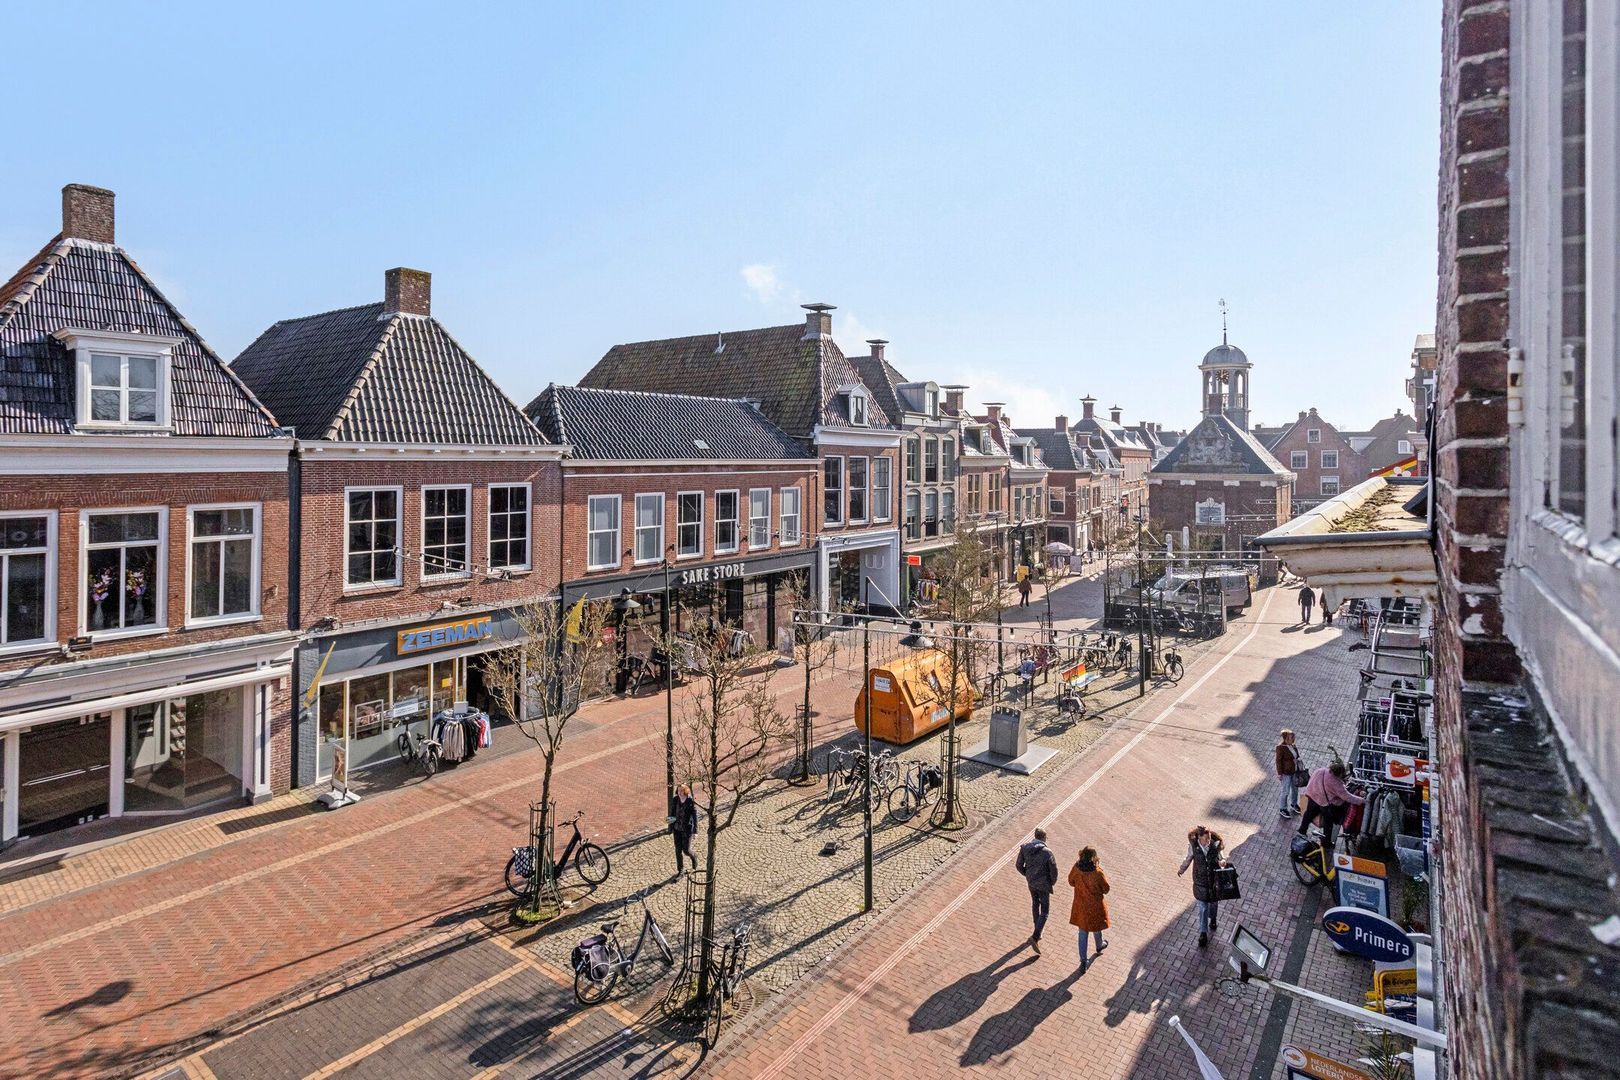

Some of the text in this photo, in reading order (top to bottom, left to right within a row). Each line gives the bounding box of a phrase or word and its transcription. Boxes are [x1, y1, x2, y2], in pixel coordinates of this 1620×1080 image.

[682, 563, 745, 585] SAKE STORE
[402, 620, 493, 651] ZEEMAN
[1355, 926, 1410, 956] Primera
[1311, 1063, 1344, 1080] LOTERIJ
